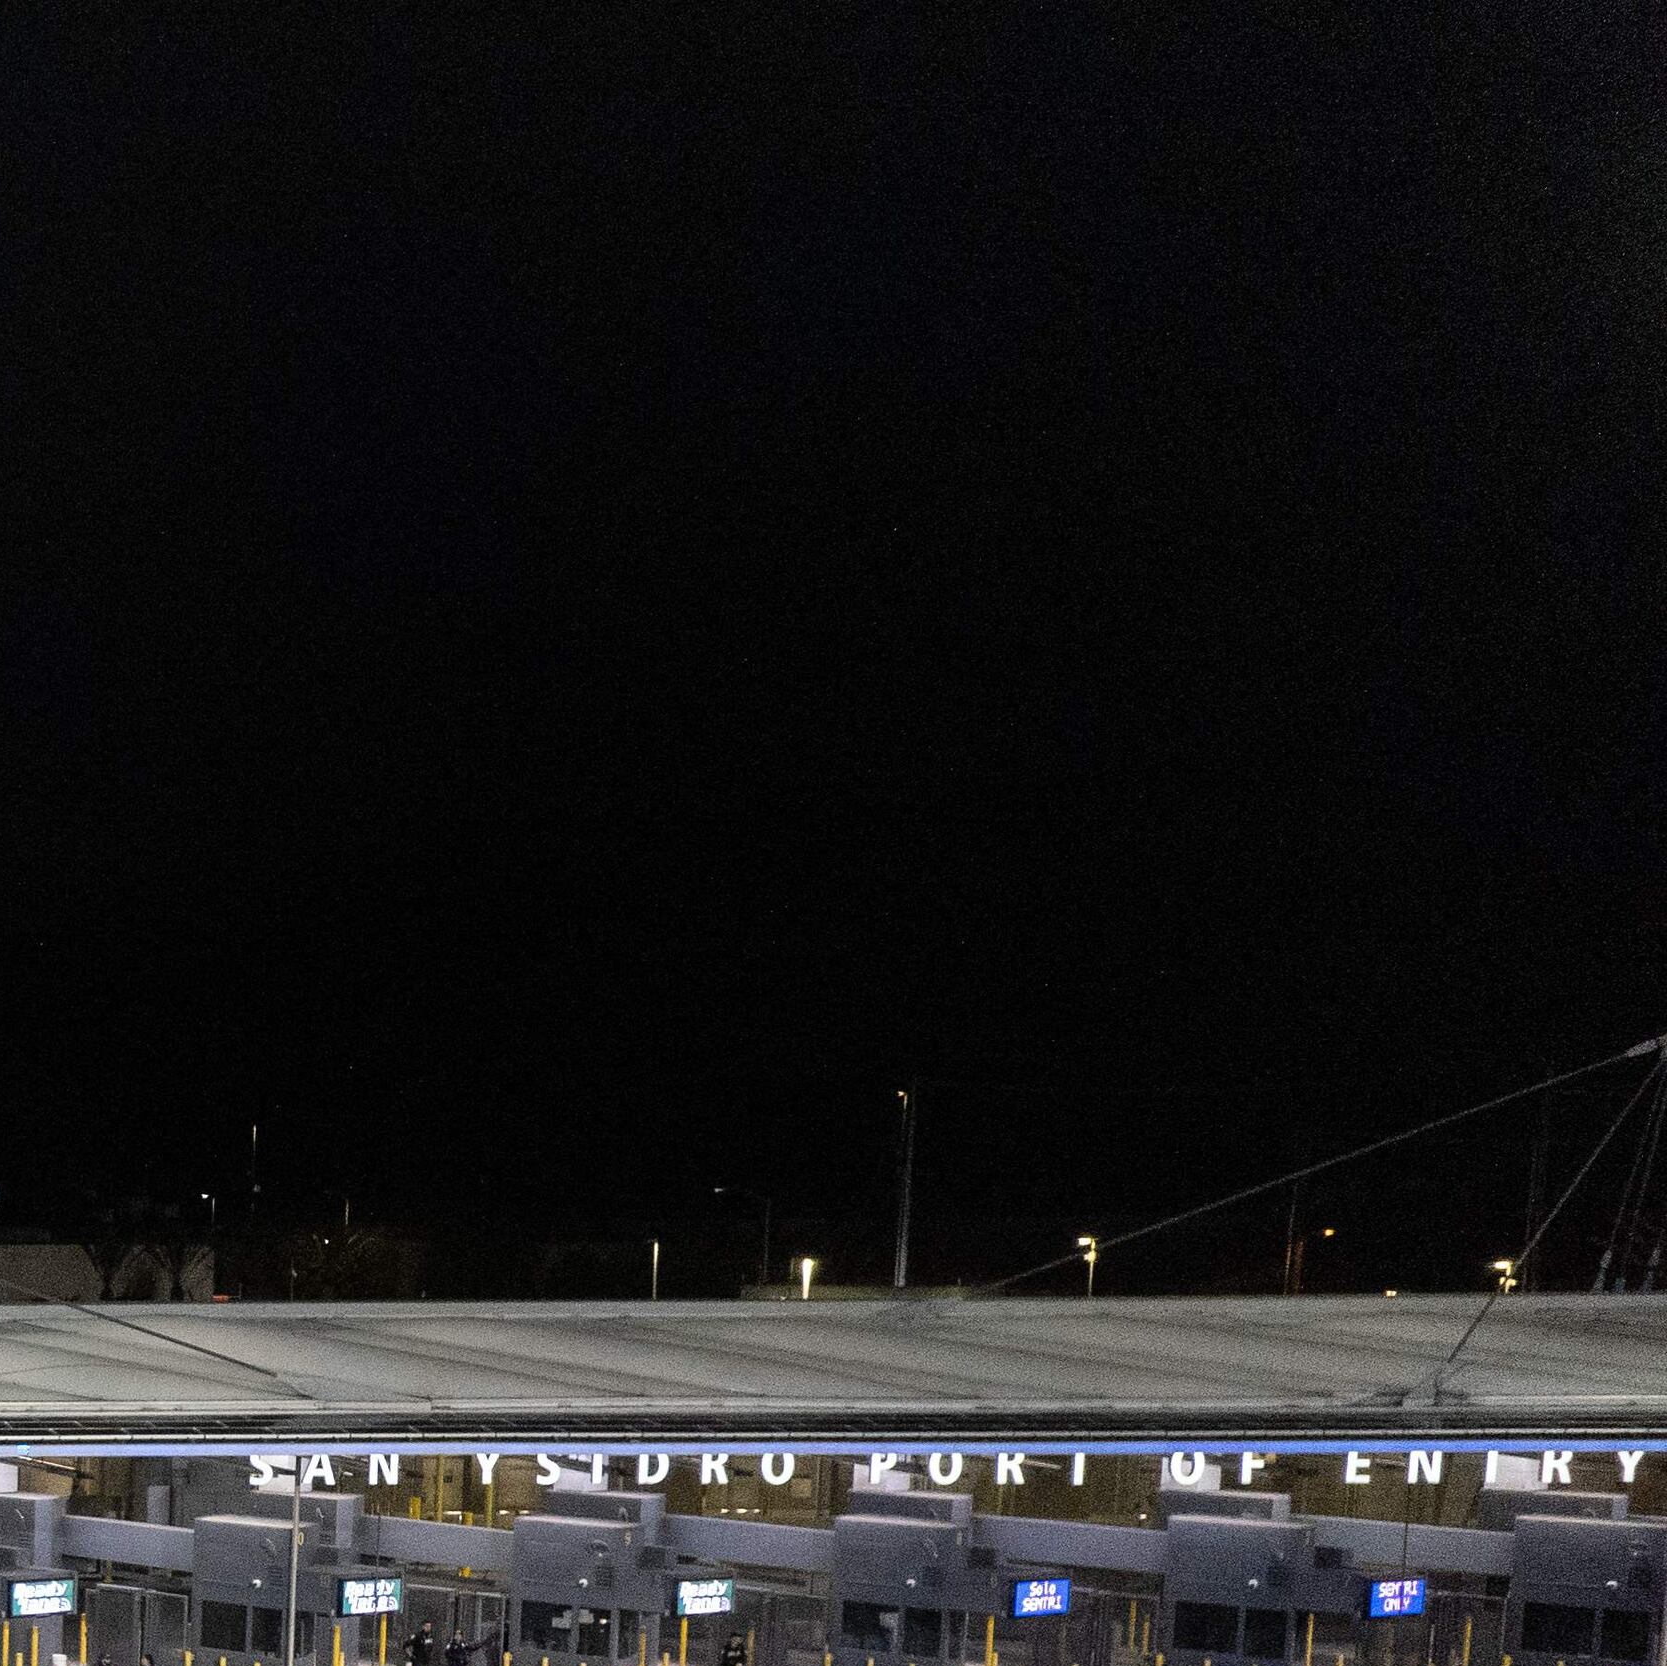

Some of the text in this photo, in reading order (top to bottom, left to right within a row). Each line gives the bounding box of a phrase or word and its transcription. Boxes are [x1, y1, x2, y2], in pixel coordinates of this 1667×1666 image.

[249, 1453, 400, 1486] SAN
[476, 1453, 794, 1487] YSIDRO
[1169, 1452, 1266, 1486] OF
[14, 1581, 67, 1598] Ready
[679, 1580, 728, 1598] Ready
[1030, 1582, 1057, 1597] Solo
[1021, 1596, 1062, 1612] SENTRI
